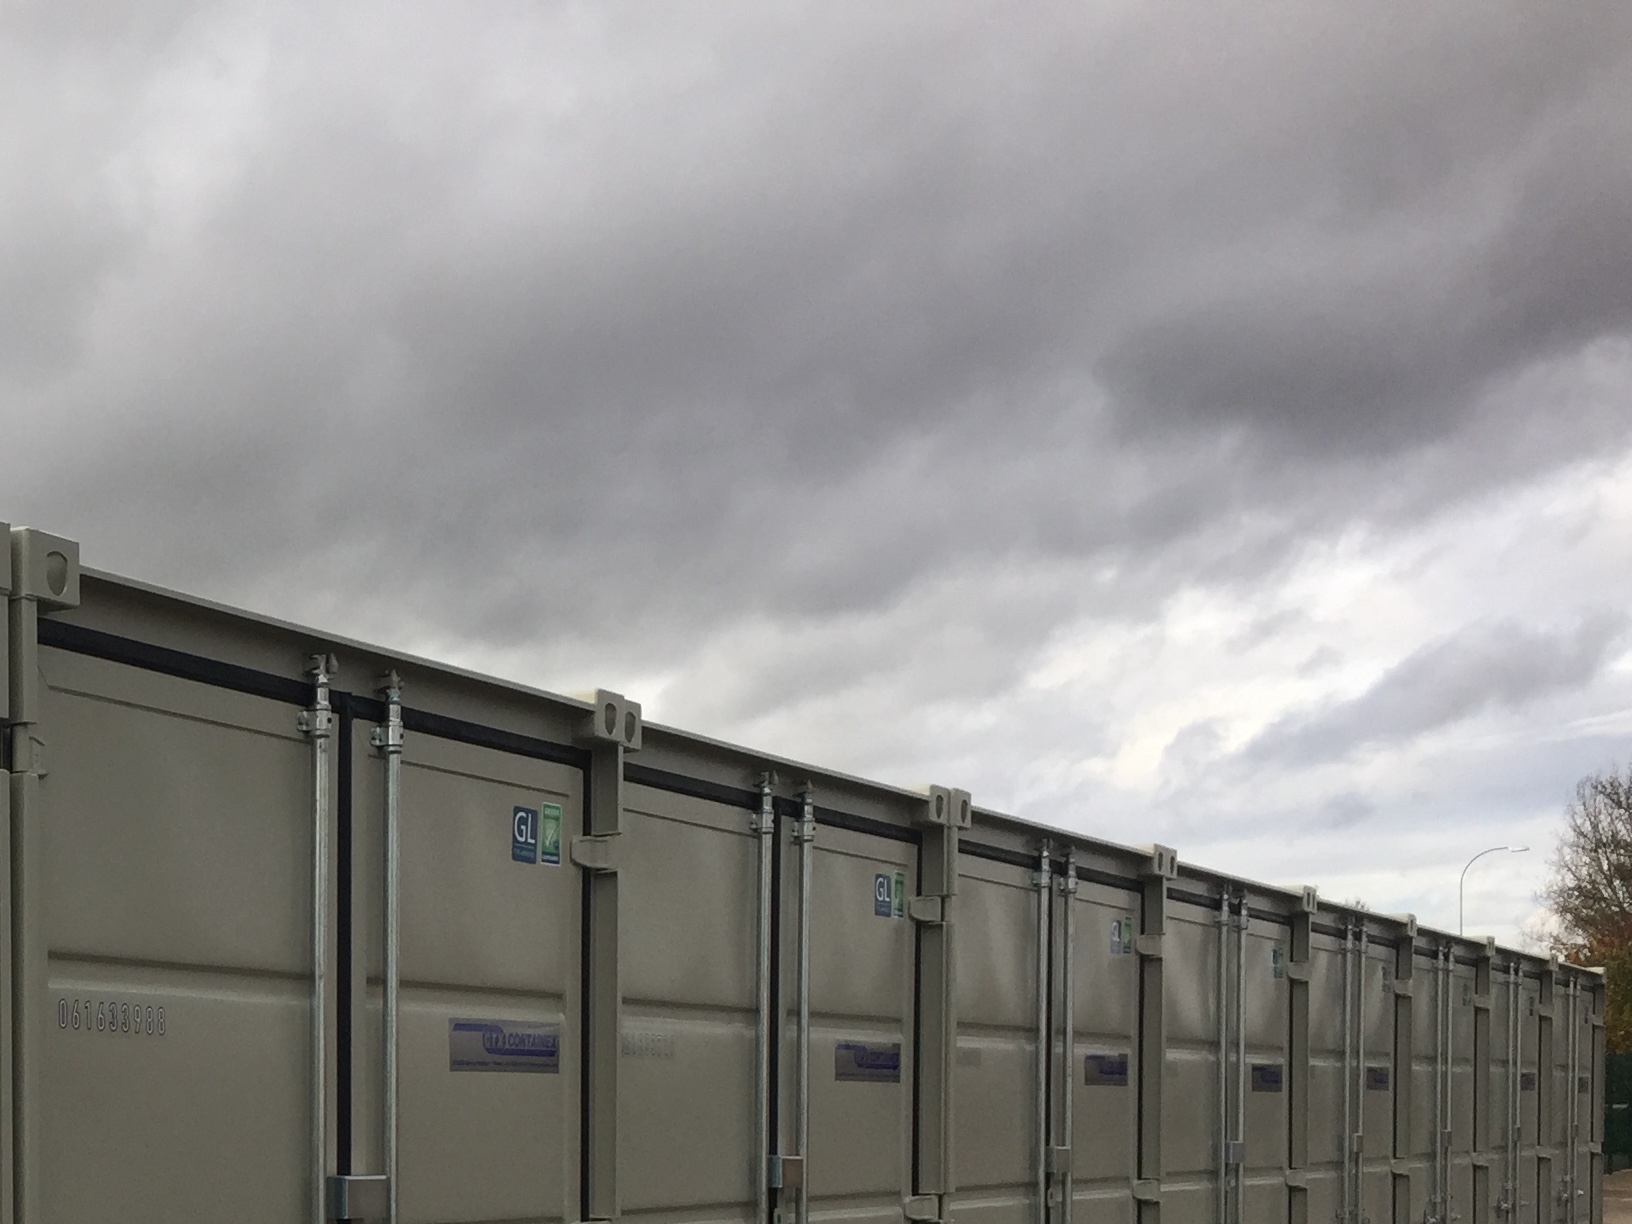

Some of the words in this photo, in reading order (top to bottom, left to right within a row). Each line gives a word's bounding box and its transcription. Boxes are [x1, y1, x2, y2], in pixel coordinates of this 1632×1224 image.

[514, 811, 536, 843] GL
[876, 878, 890, 901] GL
[58, 998, 166, 1036] 061633988
